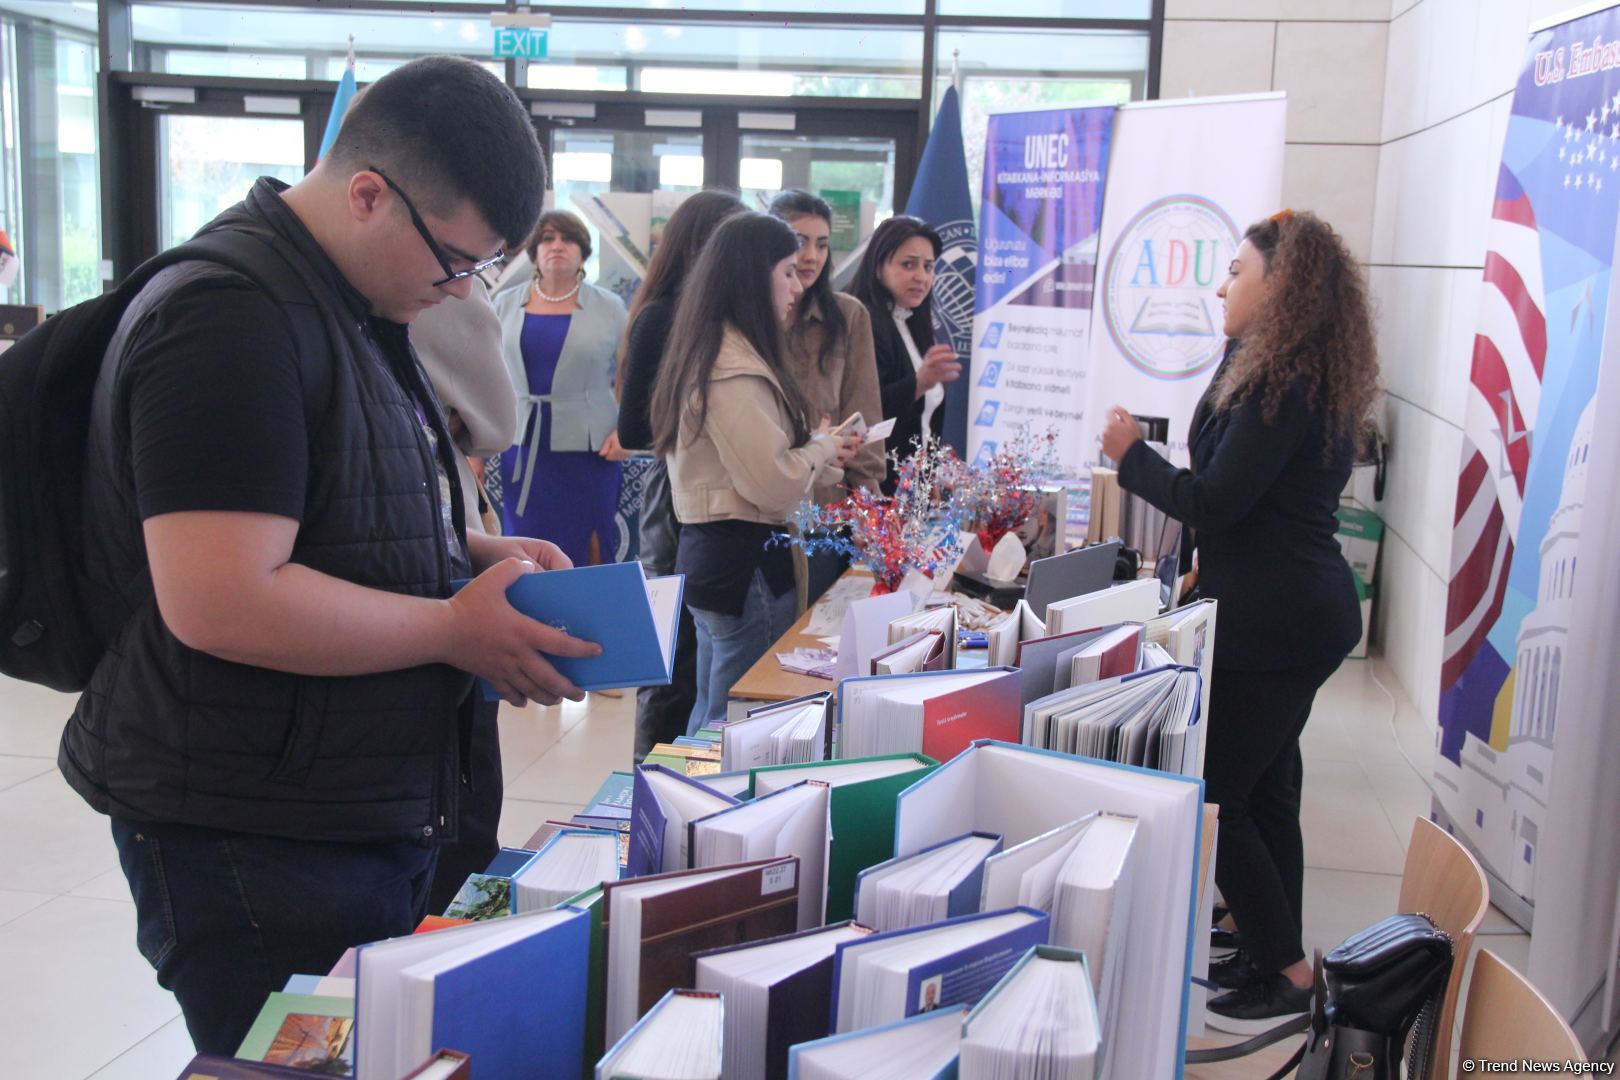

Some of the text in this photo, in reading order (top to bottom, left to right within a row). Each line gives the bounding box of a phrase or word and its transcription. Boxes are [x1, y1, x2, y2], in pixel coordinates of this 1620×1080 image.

[499, 32, 544, 55] EXIT
[1534, 47, 1565, 86] U.S.
[1024, 133, 1069, 169] UNEC
[1130, 239, 1218, 288] ADU
